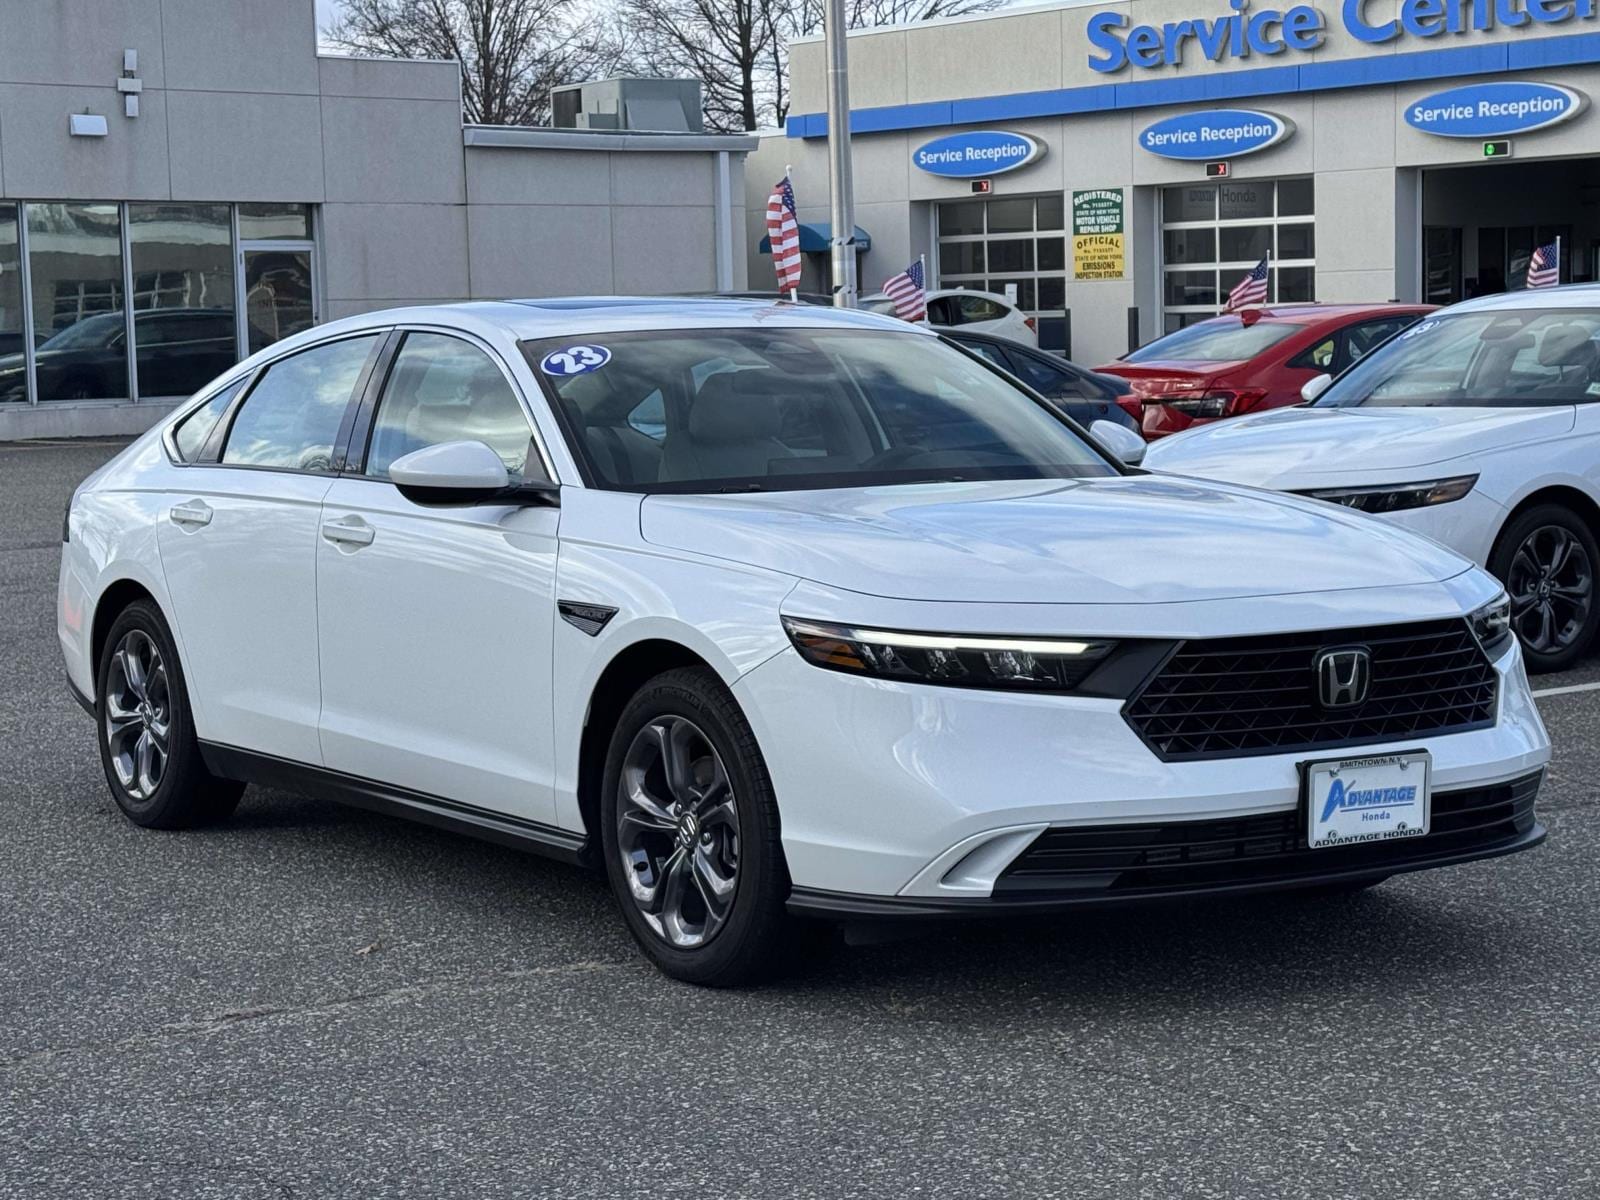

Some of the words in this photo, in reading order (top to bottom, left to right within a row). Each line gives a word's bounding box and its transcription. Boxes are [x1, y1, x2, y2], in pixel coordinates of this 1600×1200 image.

[1087, 0, 1325, 73] Service
[1414, 104, 1473, 122] Service
[1478, 96, 1564, 118] Reception
[1147, 130, 1197, 146] Service
[1201, 123, 1272, 143] Reception
[920, 149, 963, 164] Service
[966, 144, 1026, 161] Reception
[1074, 191, 1122, 206] REGISTERED
[1076, 216, 1096, 225] MOTOR
[1096, 215, 1120, 224] VEHICLE
[1080, 225, 1100, 233] REPAIR
[1101, 224, 1117, 233] SHOP
[1076, 236, 1120, 249] OFFICIAL
[1083, 261, 1116, 271] EMISSIONS
[1075, 271, 1103, 279] INSPECTION
[549, 346, 604, 374] 23
[1340, 758, 1387, 768] SMITHTOWN
[1320, 778, 1417, 823] ADVANTAGE
[1361, 811, 1391, 822] Honda
[1314, 833, 1381, 847] ADVANTAGE
[1383, 828, 1424, 839] HONDA
